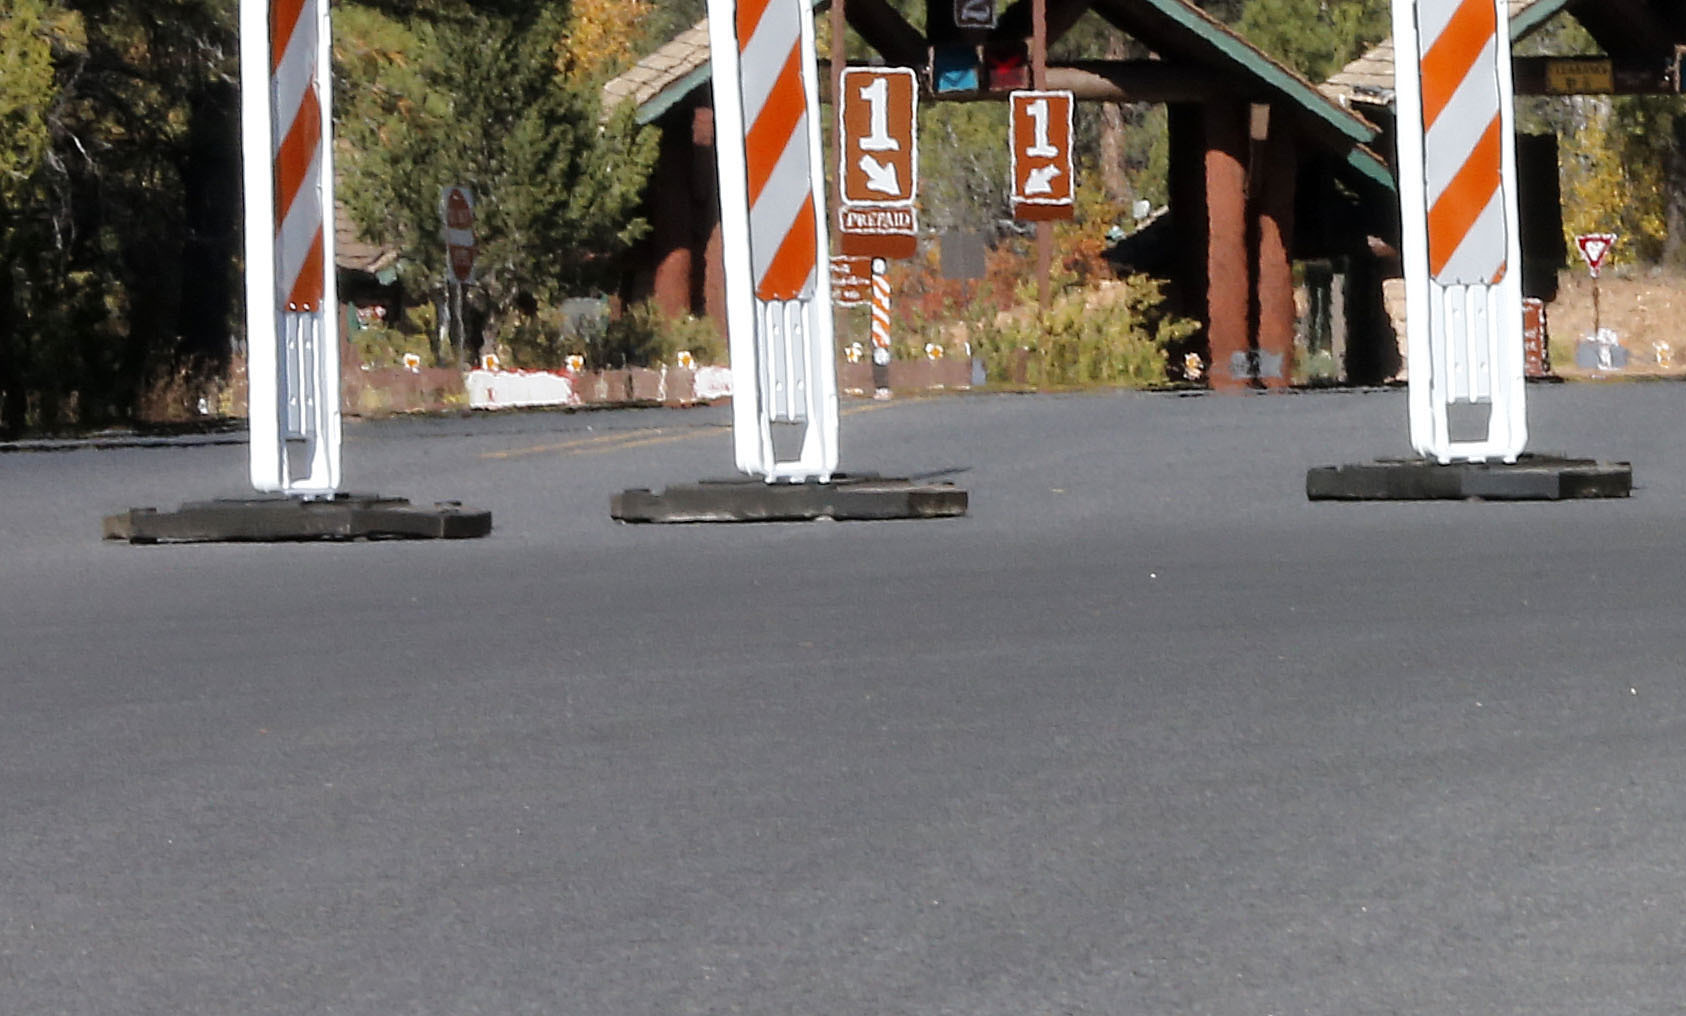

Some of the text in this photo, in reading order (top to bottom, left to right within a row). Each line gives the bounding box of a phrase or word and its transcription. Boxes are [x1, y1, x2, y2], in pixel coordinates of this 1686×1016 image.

[859, 77, 900, 151] 1
[1026, 99, 1059, 157] 1
[847, 211, 911, 227] PREPAID
